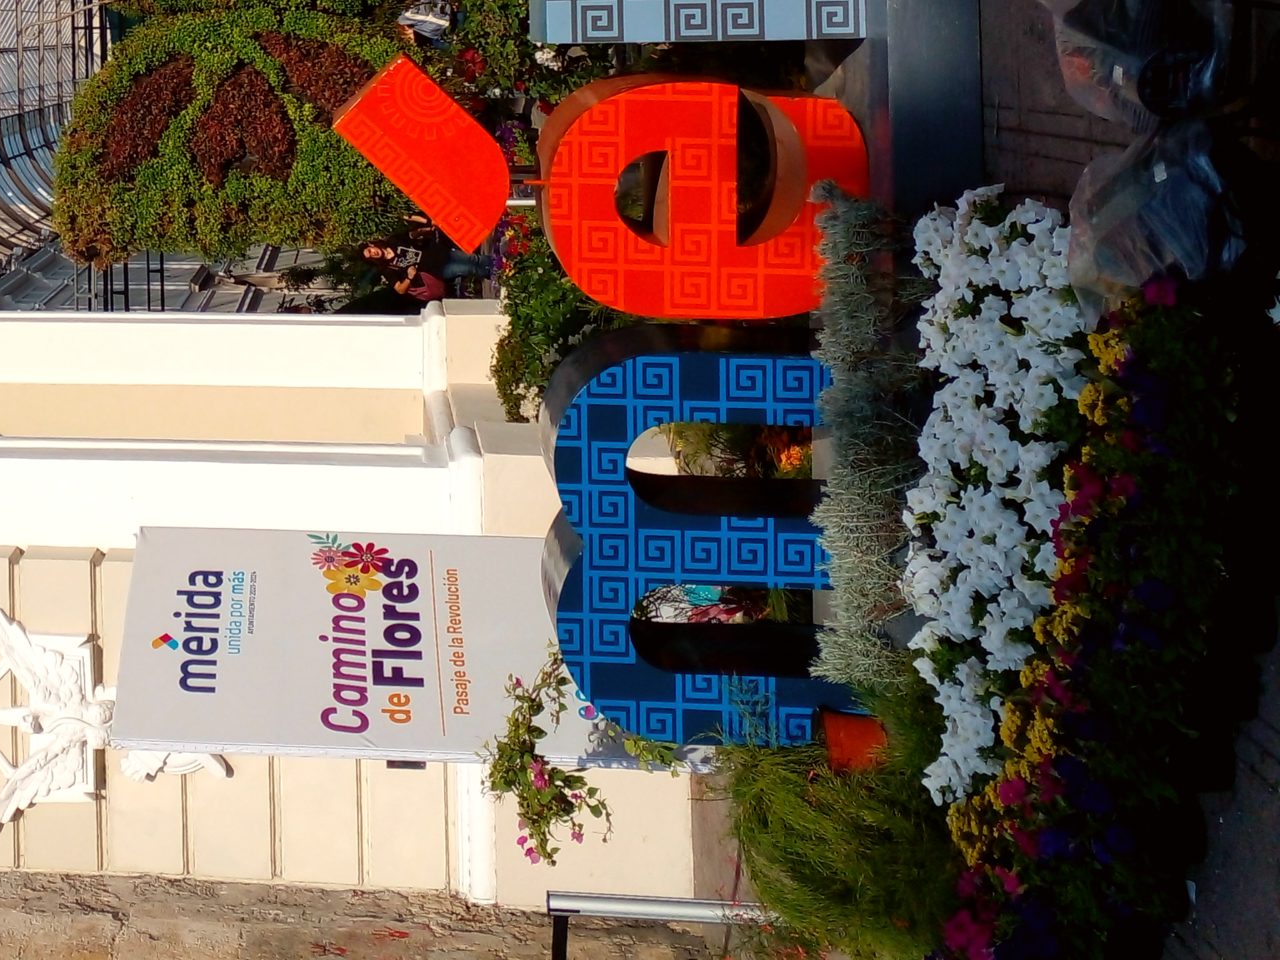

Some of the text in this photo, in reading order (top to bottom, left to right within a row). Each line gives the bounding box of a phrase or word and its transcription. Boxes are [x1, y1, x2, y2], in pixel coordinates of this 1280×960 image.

[152, 570, 223, 693] mérida
[224, 571, 246, 655] unida por más
[319, 592, 370, 734] Camino
[371, 558, 424, 724] de Flores
[443, 568, 471, 715] Pasaje de la Revolución
